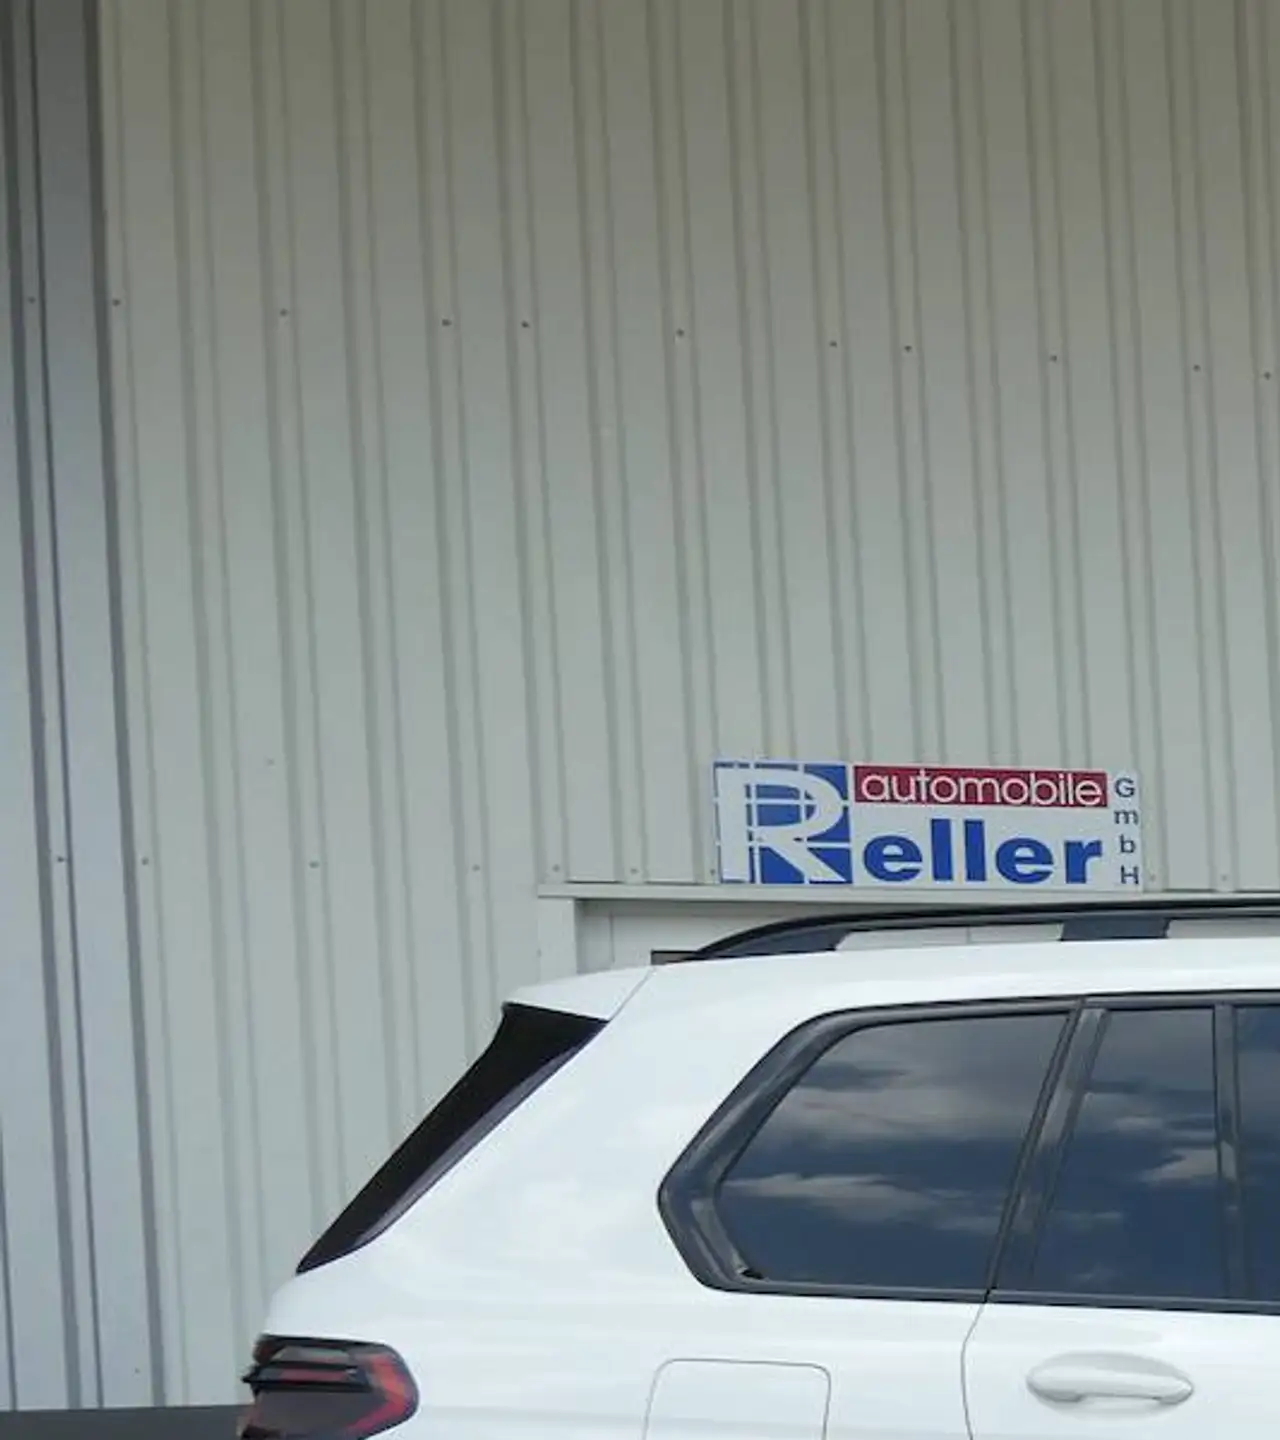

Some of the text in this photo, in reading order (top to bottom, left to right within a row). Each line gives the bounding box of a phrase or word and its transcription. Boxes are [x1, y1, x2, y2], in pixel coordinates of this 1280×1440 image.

[716, 766, 1104, 885] Reller
[861, 768, 1103, 807] automobile
[1113, 776, 1140, 886] GmbH
